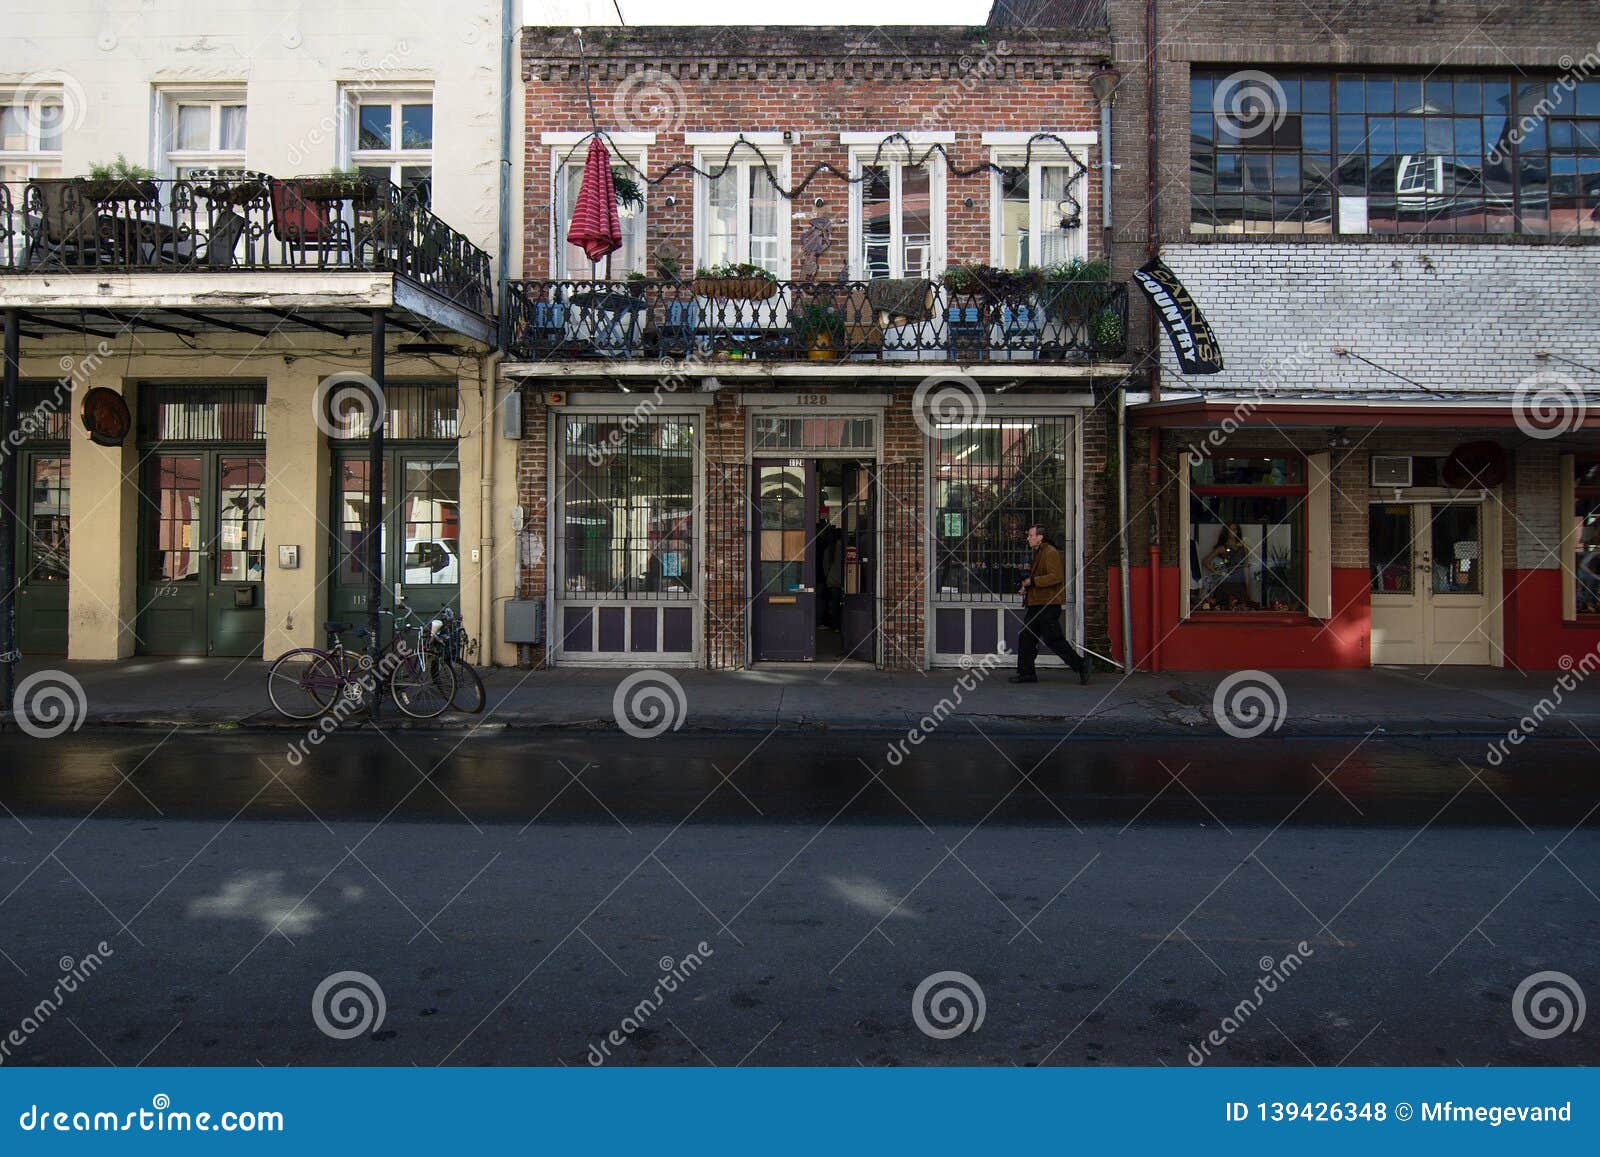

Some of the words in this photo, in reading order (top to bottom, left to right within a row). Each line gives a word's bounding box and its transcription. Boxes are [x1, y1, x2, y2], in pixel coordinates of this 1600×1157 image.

[1133, 269, 1196, 362] COUNTRY
[1149, 270, 1213, 362] SAINTS
[797, 395, 827, 405] 1128
